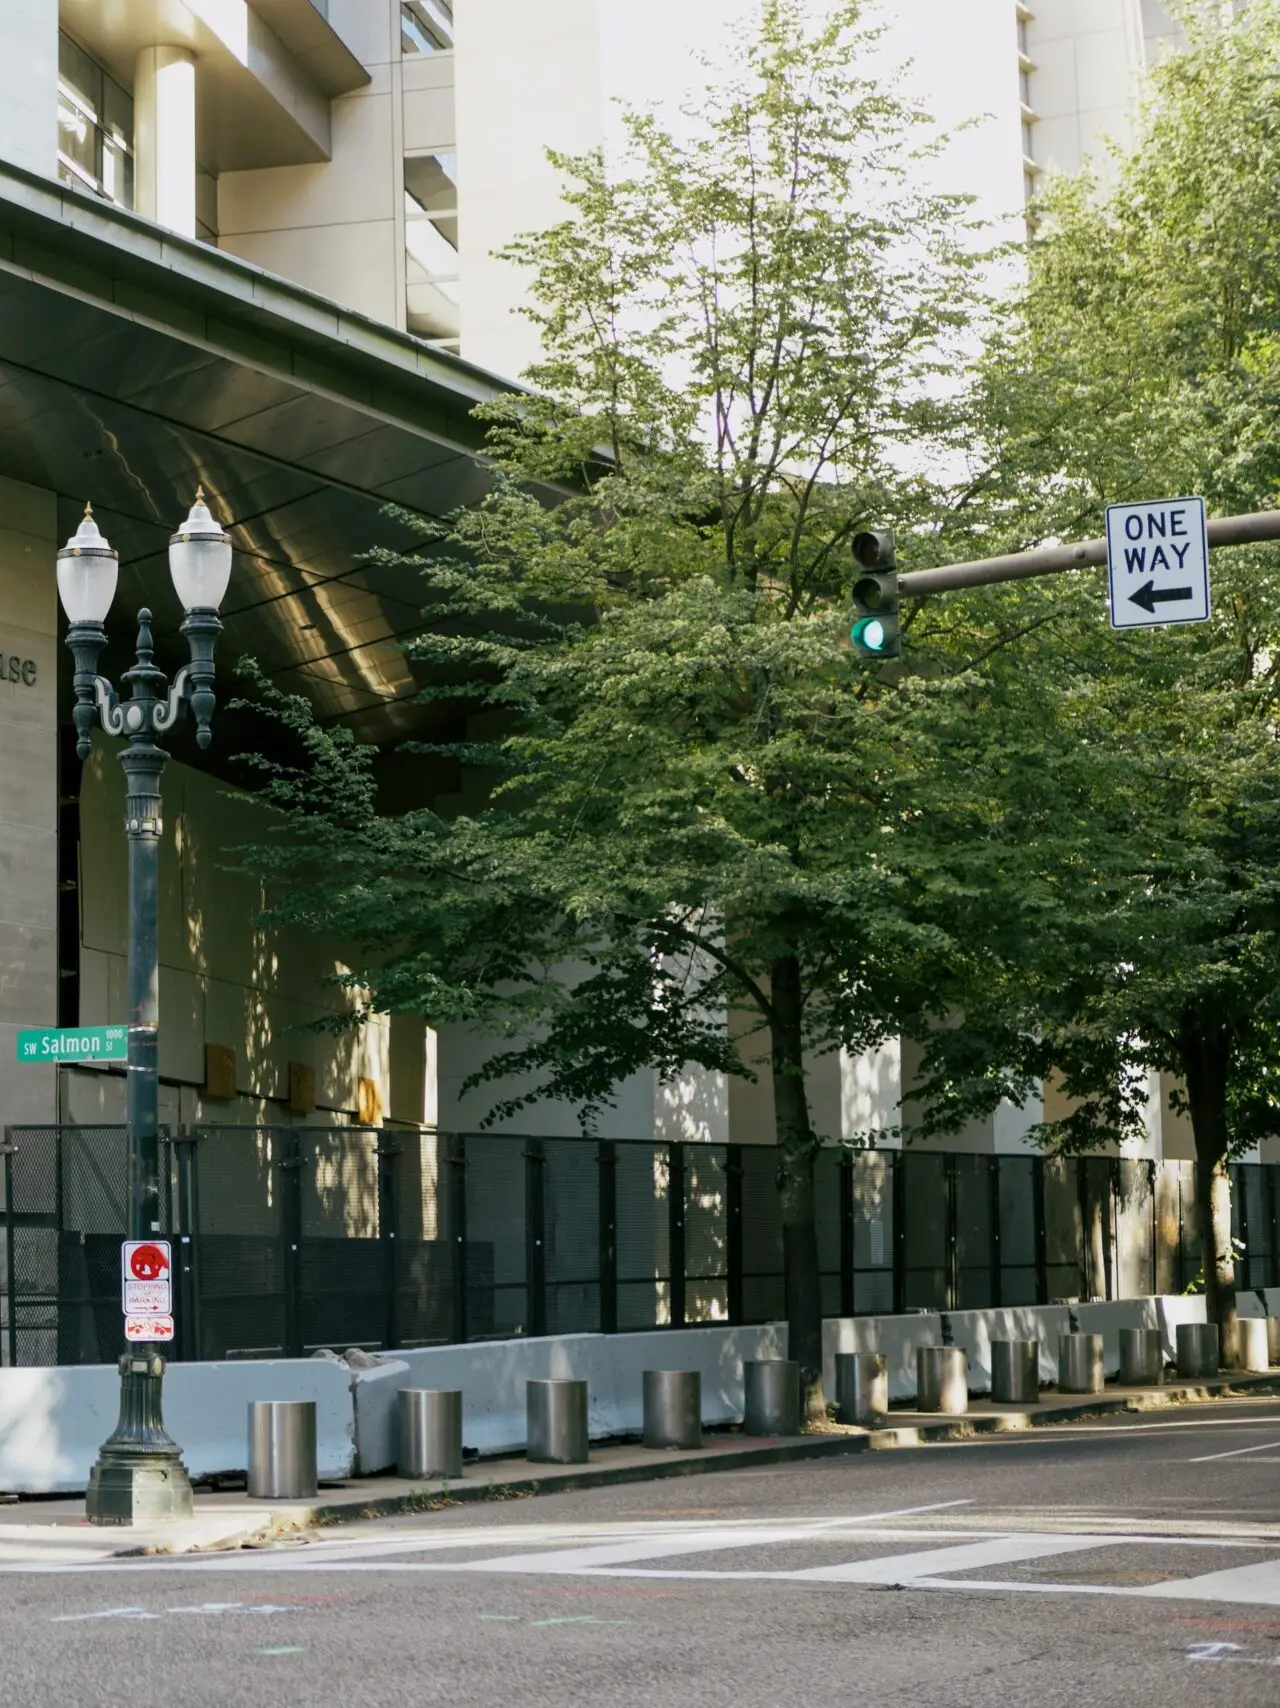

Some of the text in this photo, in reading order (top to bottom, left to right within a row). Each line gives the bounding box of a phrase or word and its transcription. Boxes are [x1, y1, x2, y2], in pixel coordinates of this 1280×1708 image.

[1125, 509, 1188, 541] ONE
[1124, 542, 1191, 574] WAY
[24, 1028, 123, 1055] SW Salmon 1000
